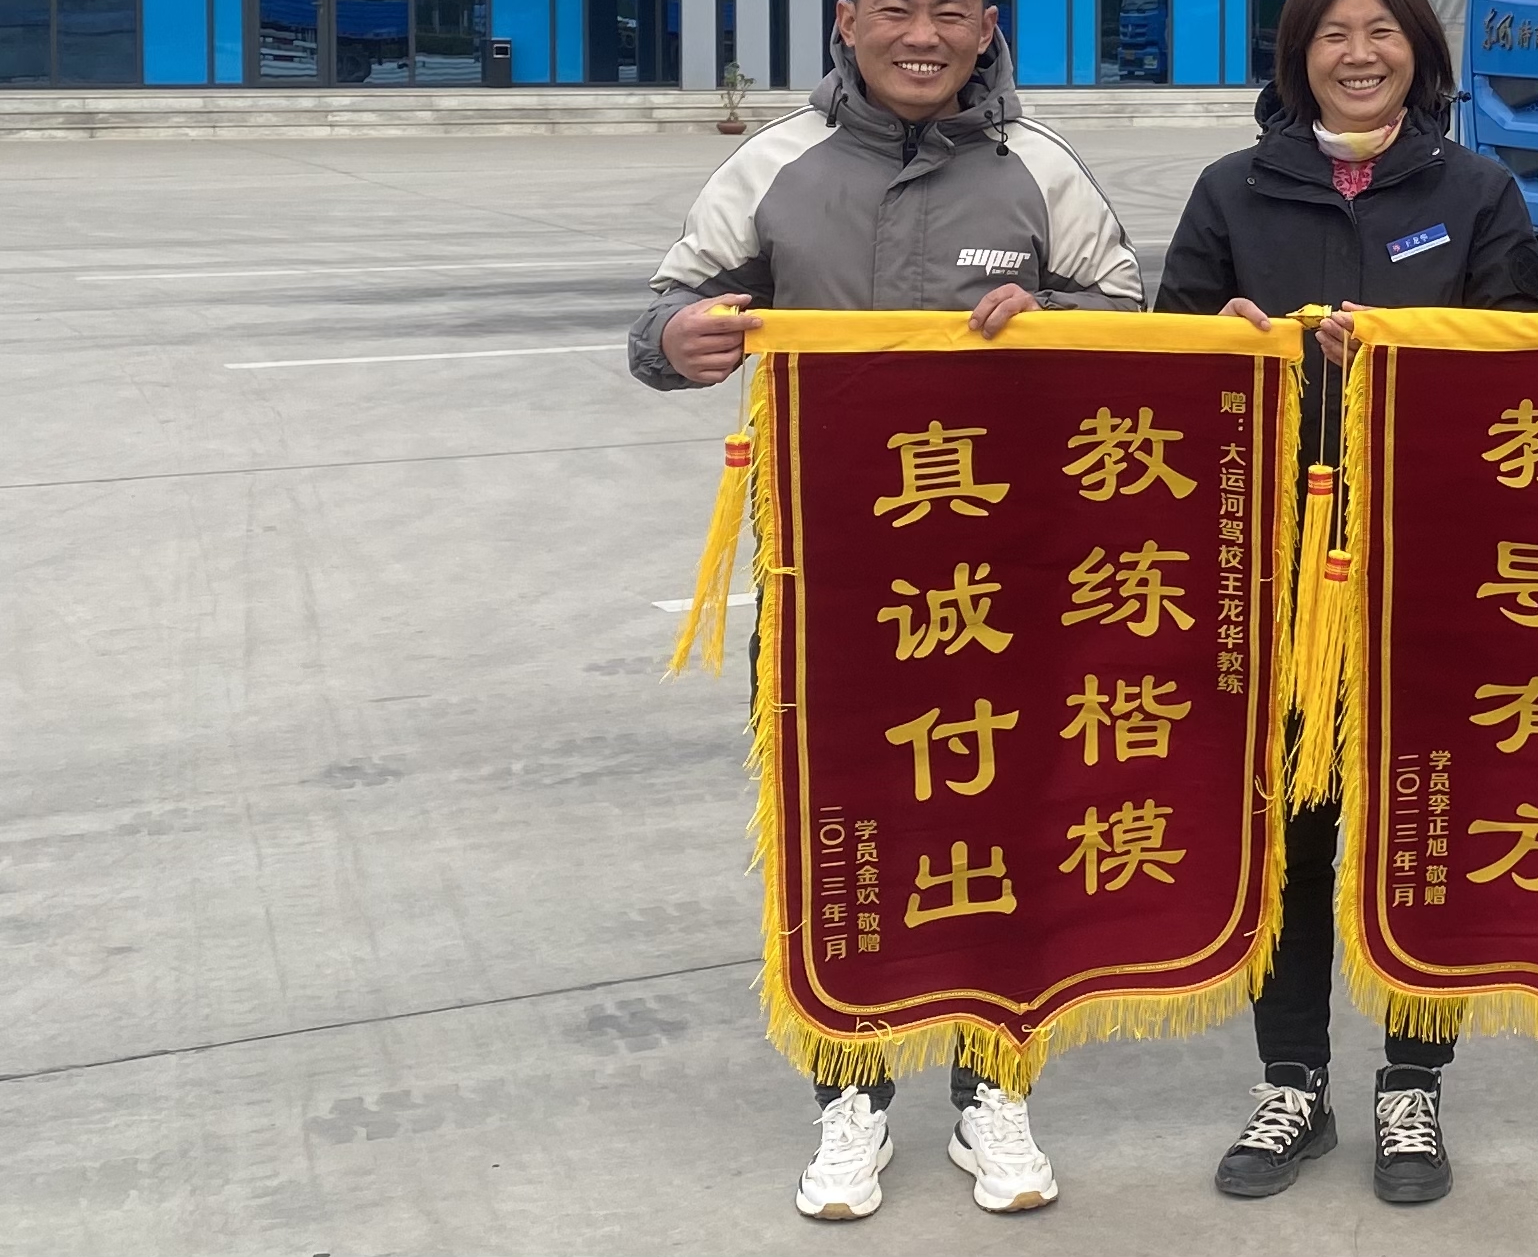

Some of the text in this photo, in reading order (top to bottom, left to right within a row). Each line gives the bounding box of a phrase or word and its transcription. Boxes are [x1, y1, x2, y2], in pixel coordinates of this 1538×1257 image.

[956, 248, 1031, 277] super
[873, 421, 1019, 928] 真诚付出
[1059, 407, 1198, 896] 教练楷模
